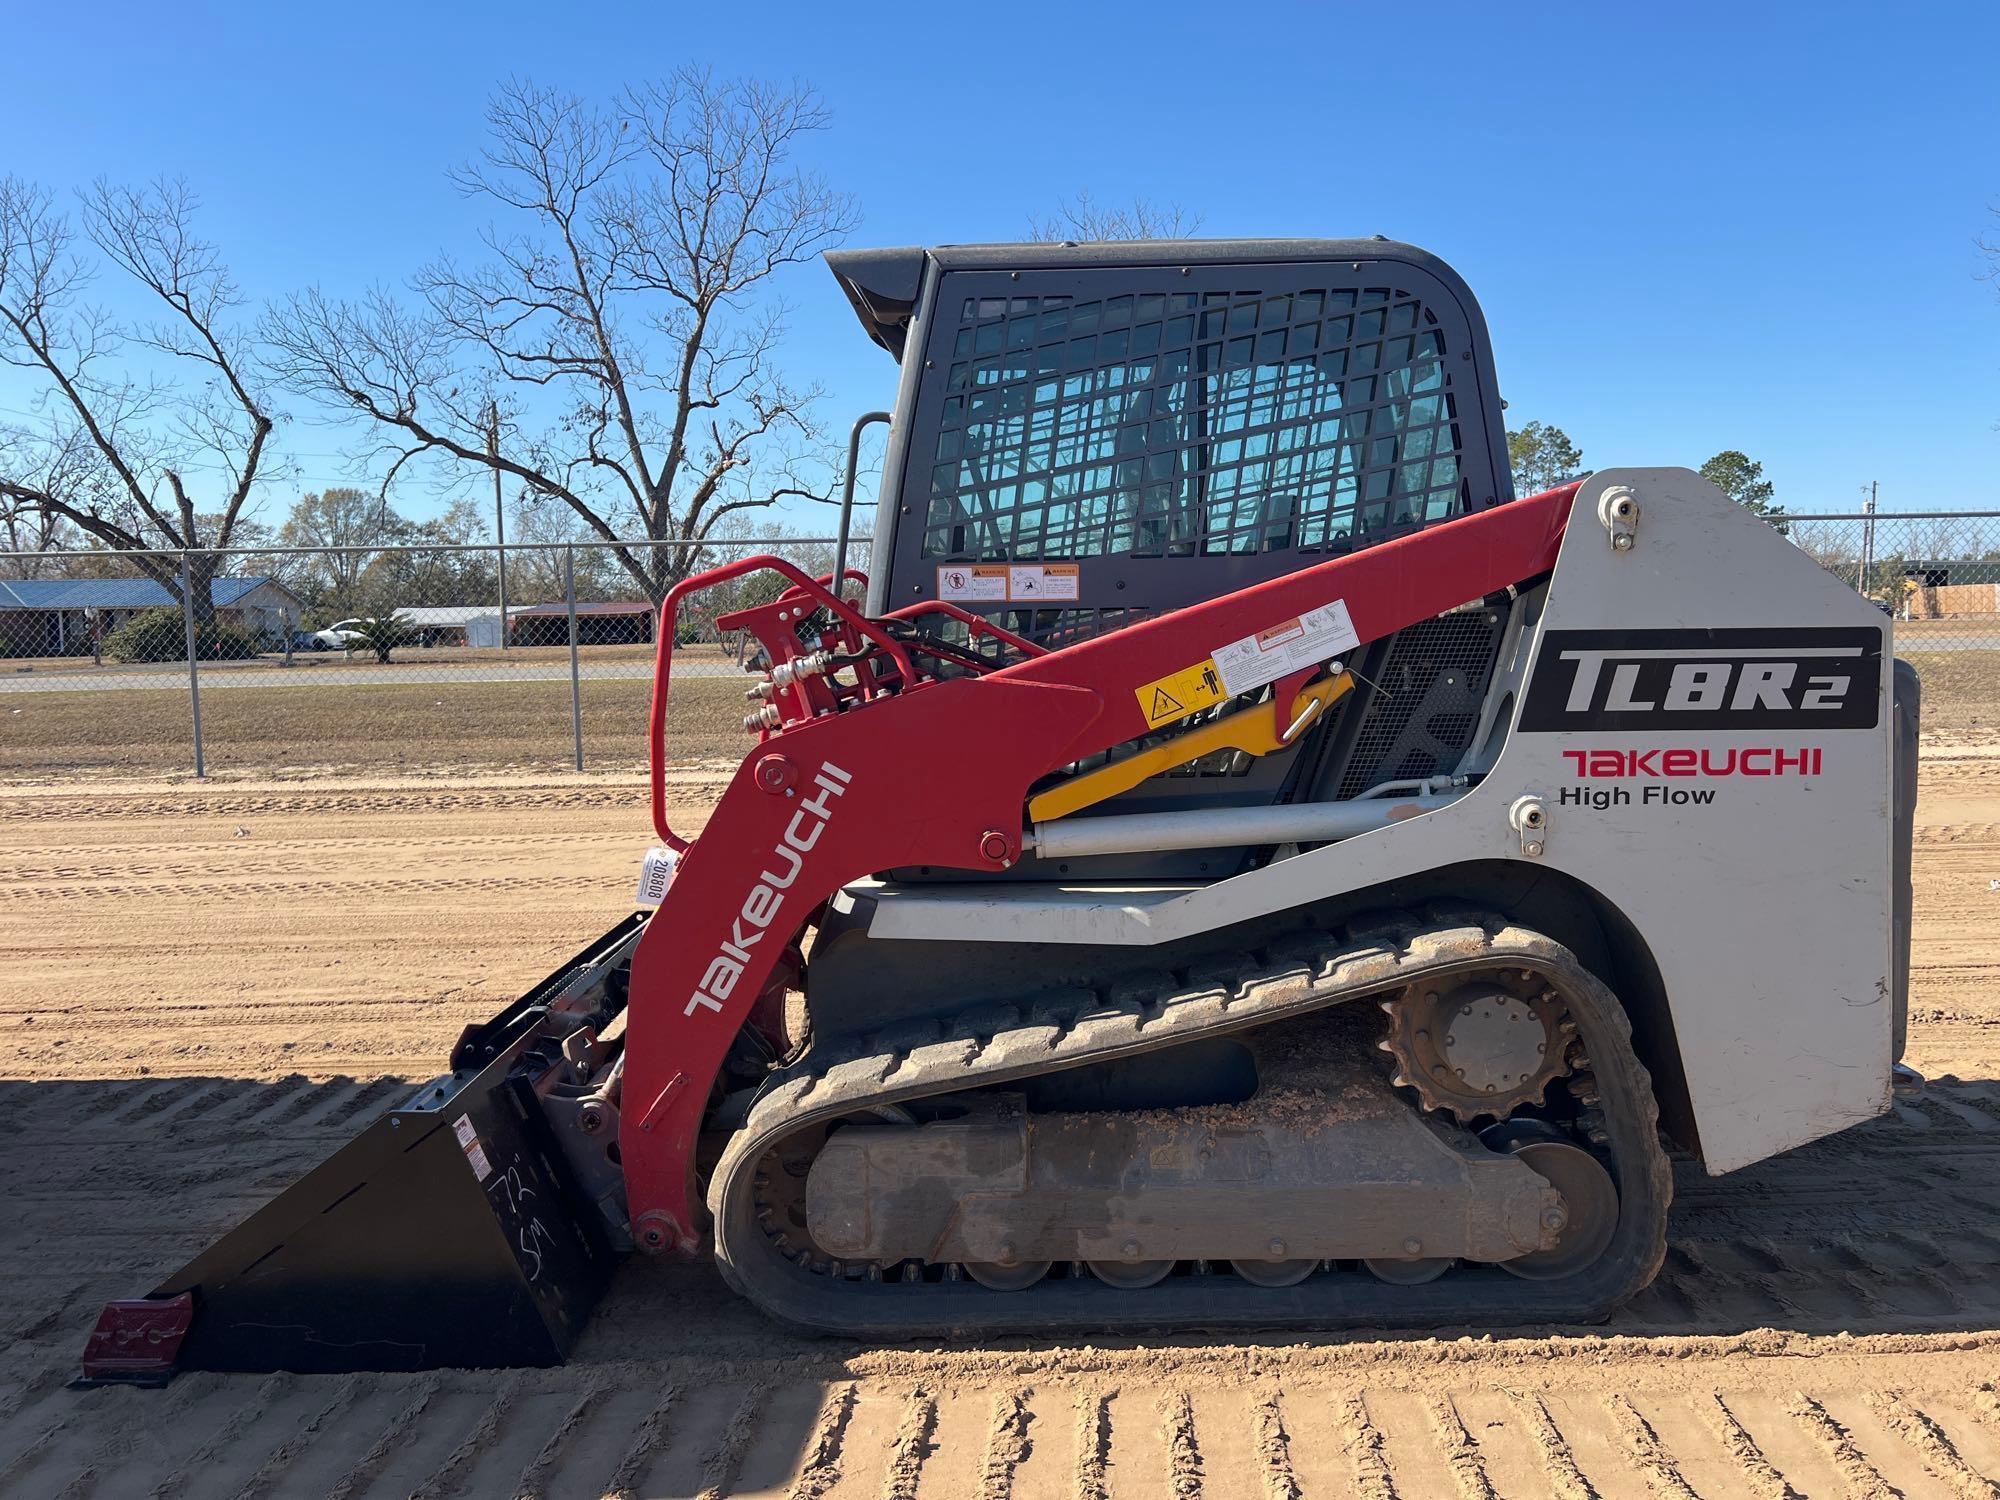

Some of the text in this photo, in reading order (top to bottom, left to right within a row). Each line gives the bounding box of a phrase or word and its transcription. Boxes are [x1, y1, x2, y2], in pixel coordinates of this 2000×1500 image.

[1562, 748, 1822, 778] TAKEUCHI
[1560, 785, 1716, 811] High Flow
[647, 859, 669, 899] 208808
[683, 760, 853, 1017] TAKEUCHI
